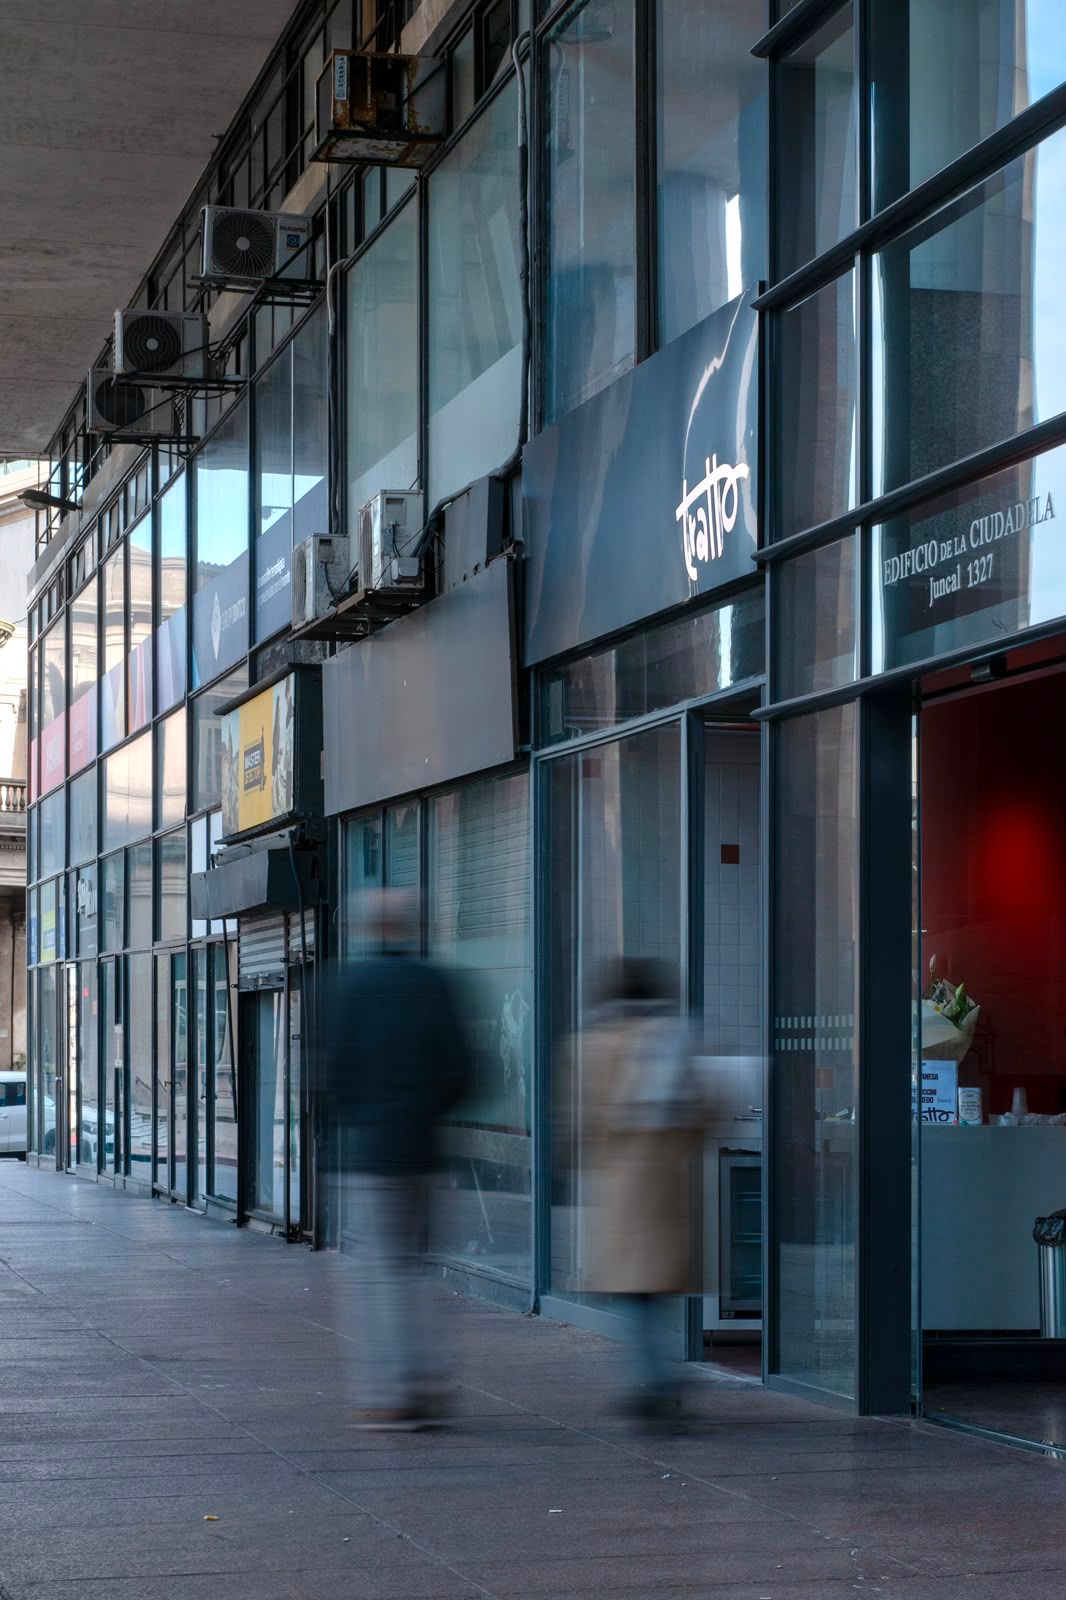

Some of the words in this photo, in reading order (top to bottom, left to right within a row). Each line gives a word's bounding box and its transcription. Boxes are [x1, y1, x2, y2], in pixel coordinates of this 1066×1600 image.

[883, 539, 938, 587] EDIFICIO
[940, 540, 954, 562] DE
[954, 534, 967, 557] LA
[969, 491, 1056, 549] CIUDADELA
[929, 563, 961, 608] Juncal
[967, 552, 994, 589] 1327
